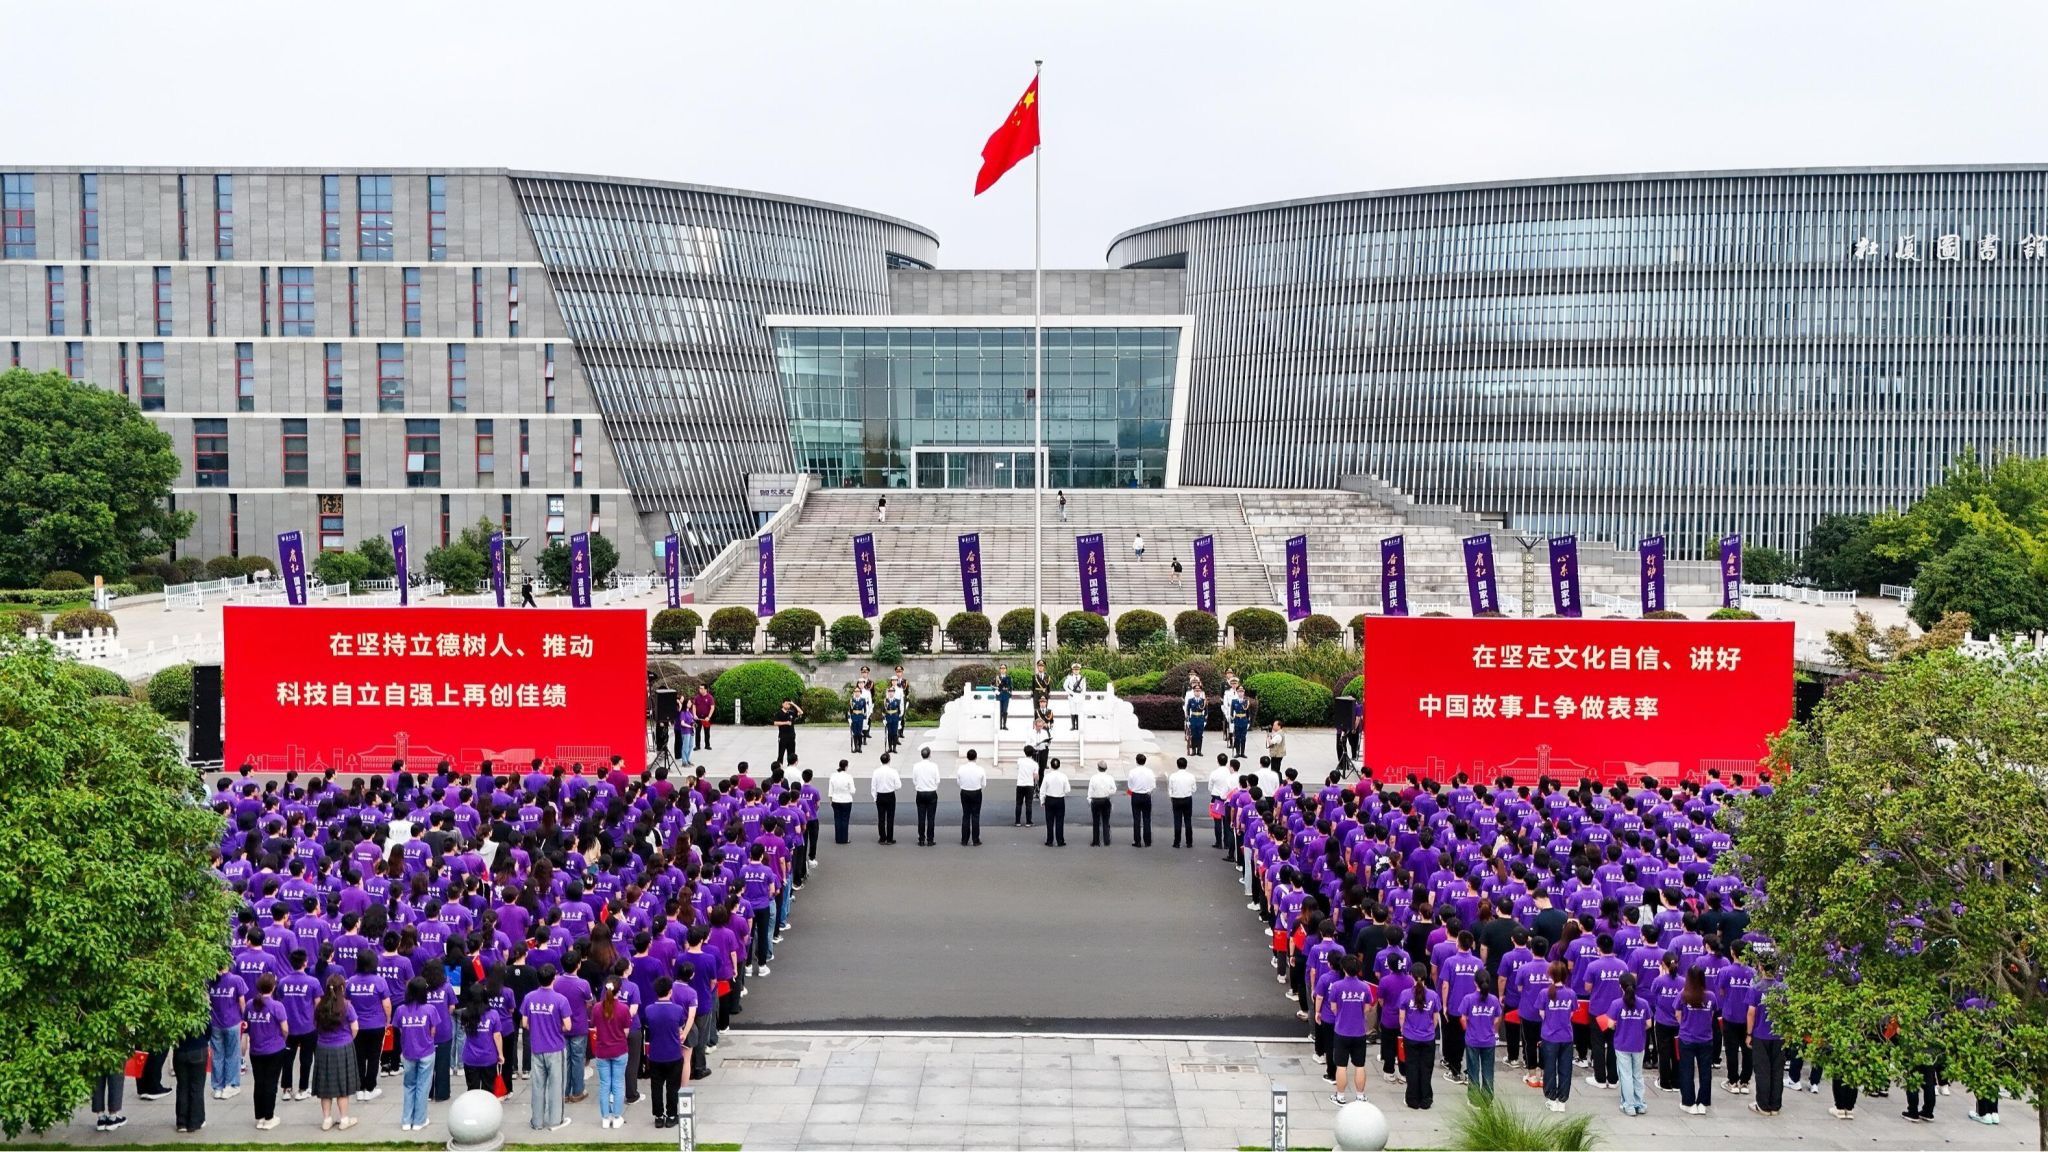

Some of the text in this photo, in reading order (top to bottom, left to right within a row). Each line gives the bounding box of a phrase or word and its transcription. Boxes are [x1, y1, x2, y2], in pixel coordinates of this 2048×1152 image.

[330, 633, 594, 658] 在坚持立德树人、推动
[1473, 645, 1742, 672] 在坚定文化自信、讲好
[277, 682, 567, 708] 科技自立自强上再创佳绩
[1419, 694, 1659, 721] 中国故事上争做表率
